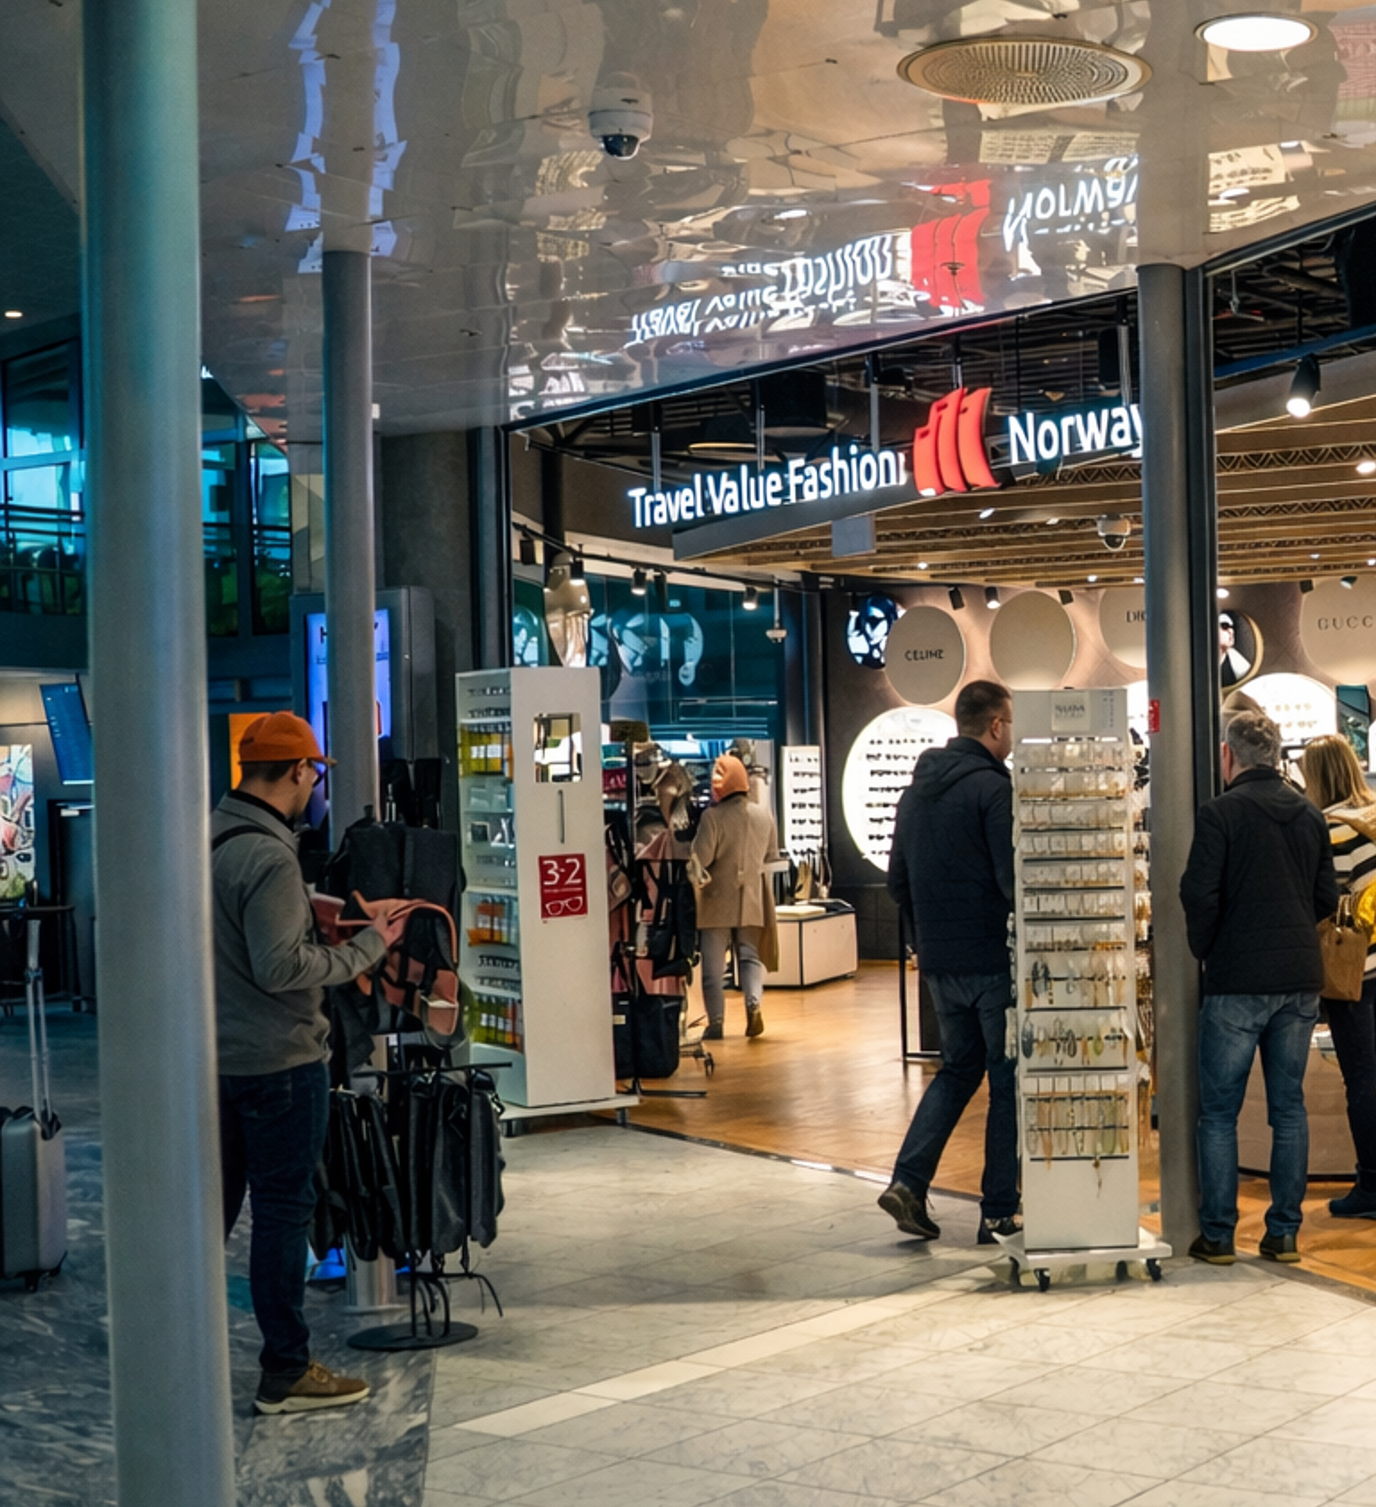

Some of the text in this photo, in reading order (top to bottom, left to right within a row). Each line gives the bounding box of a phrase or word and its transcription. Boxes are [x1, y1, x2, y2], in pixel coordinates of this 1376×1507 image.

[627, 444, 898, 528] Travel Value Fashion
